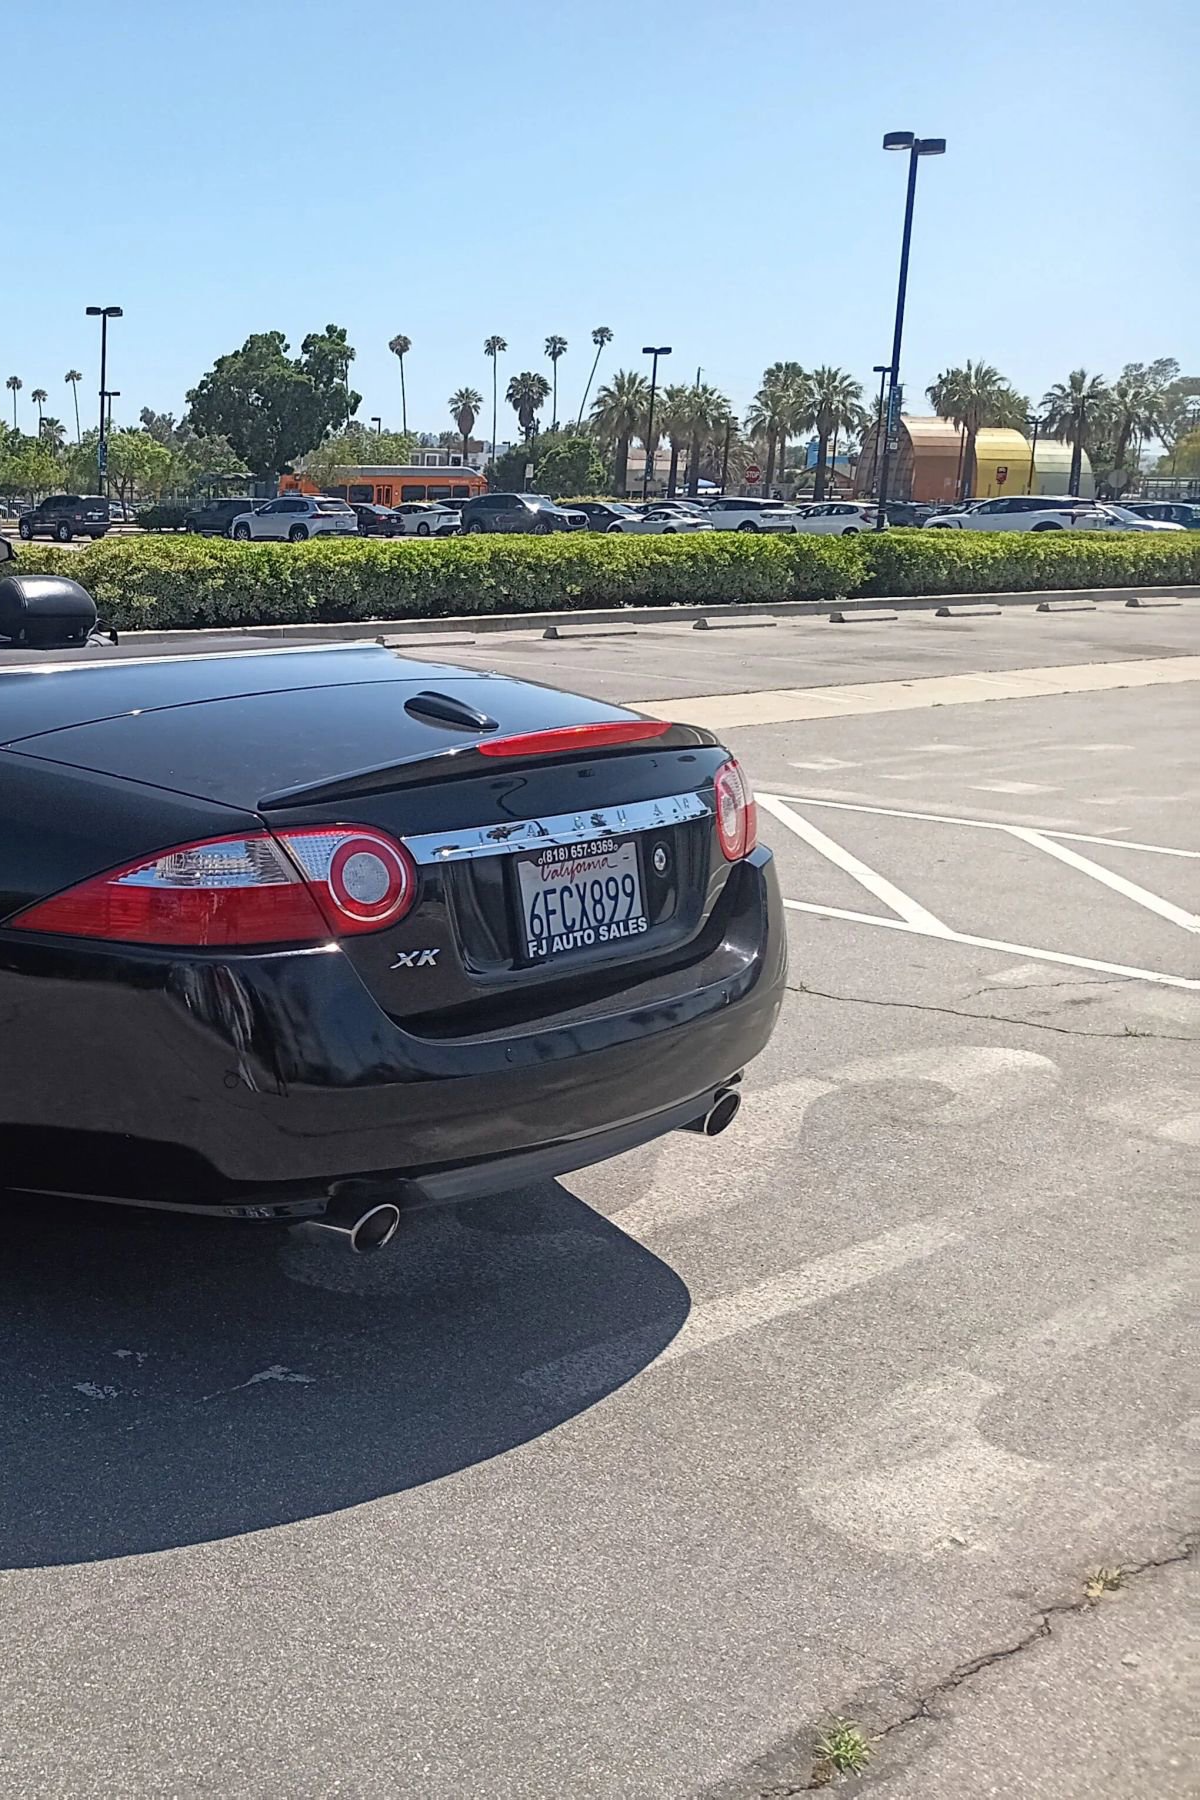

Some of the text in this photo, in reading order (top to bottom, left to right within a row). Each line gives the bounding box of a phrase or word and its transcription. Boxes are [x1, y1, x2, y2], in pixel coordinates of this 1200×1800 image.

[542, 839, 614, 864] (818) 657-9369
[541, 857, 618, 884] California
[529, 873, 636, 940] 6FCX899
[527, 917, 648, 958] FJ AUTO SALES
[390, 948, 440, 969] XK
